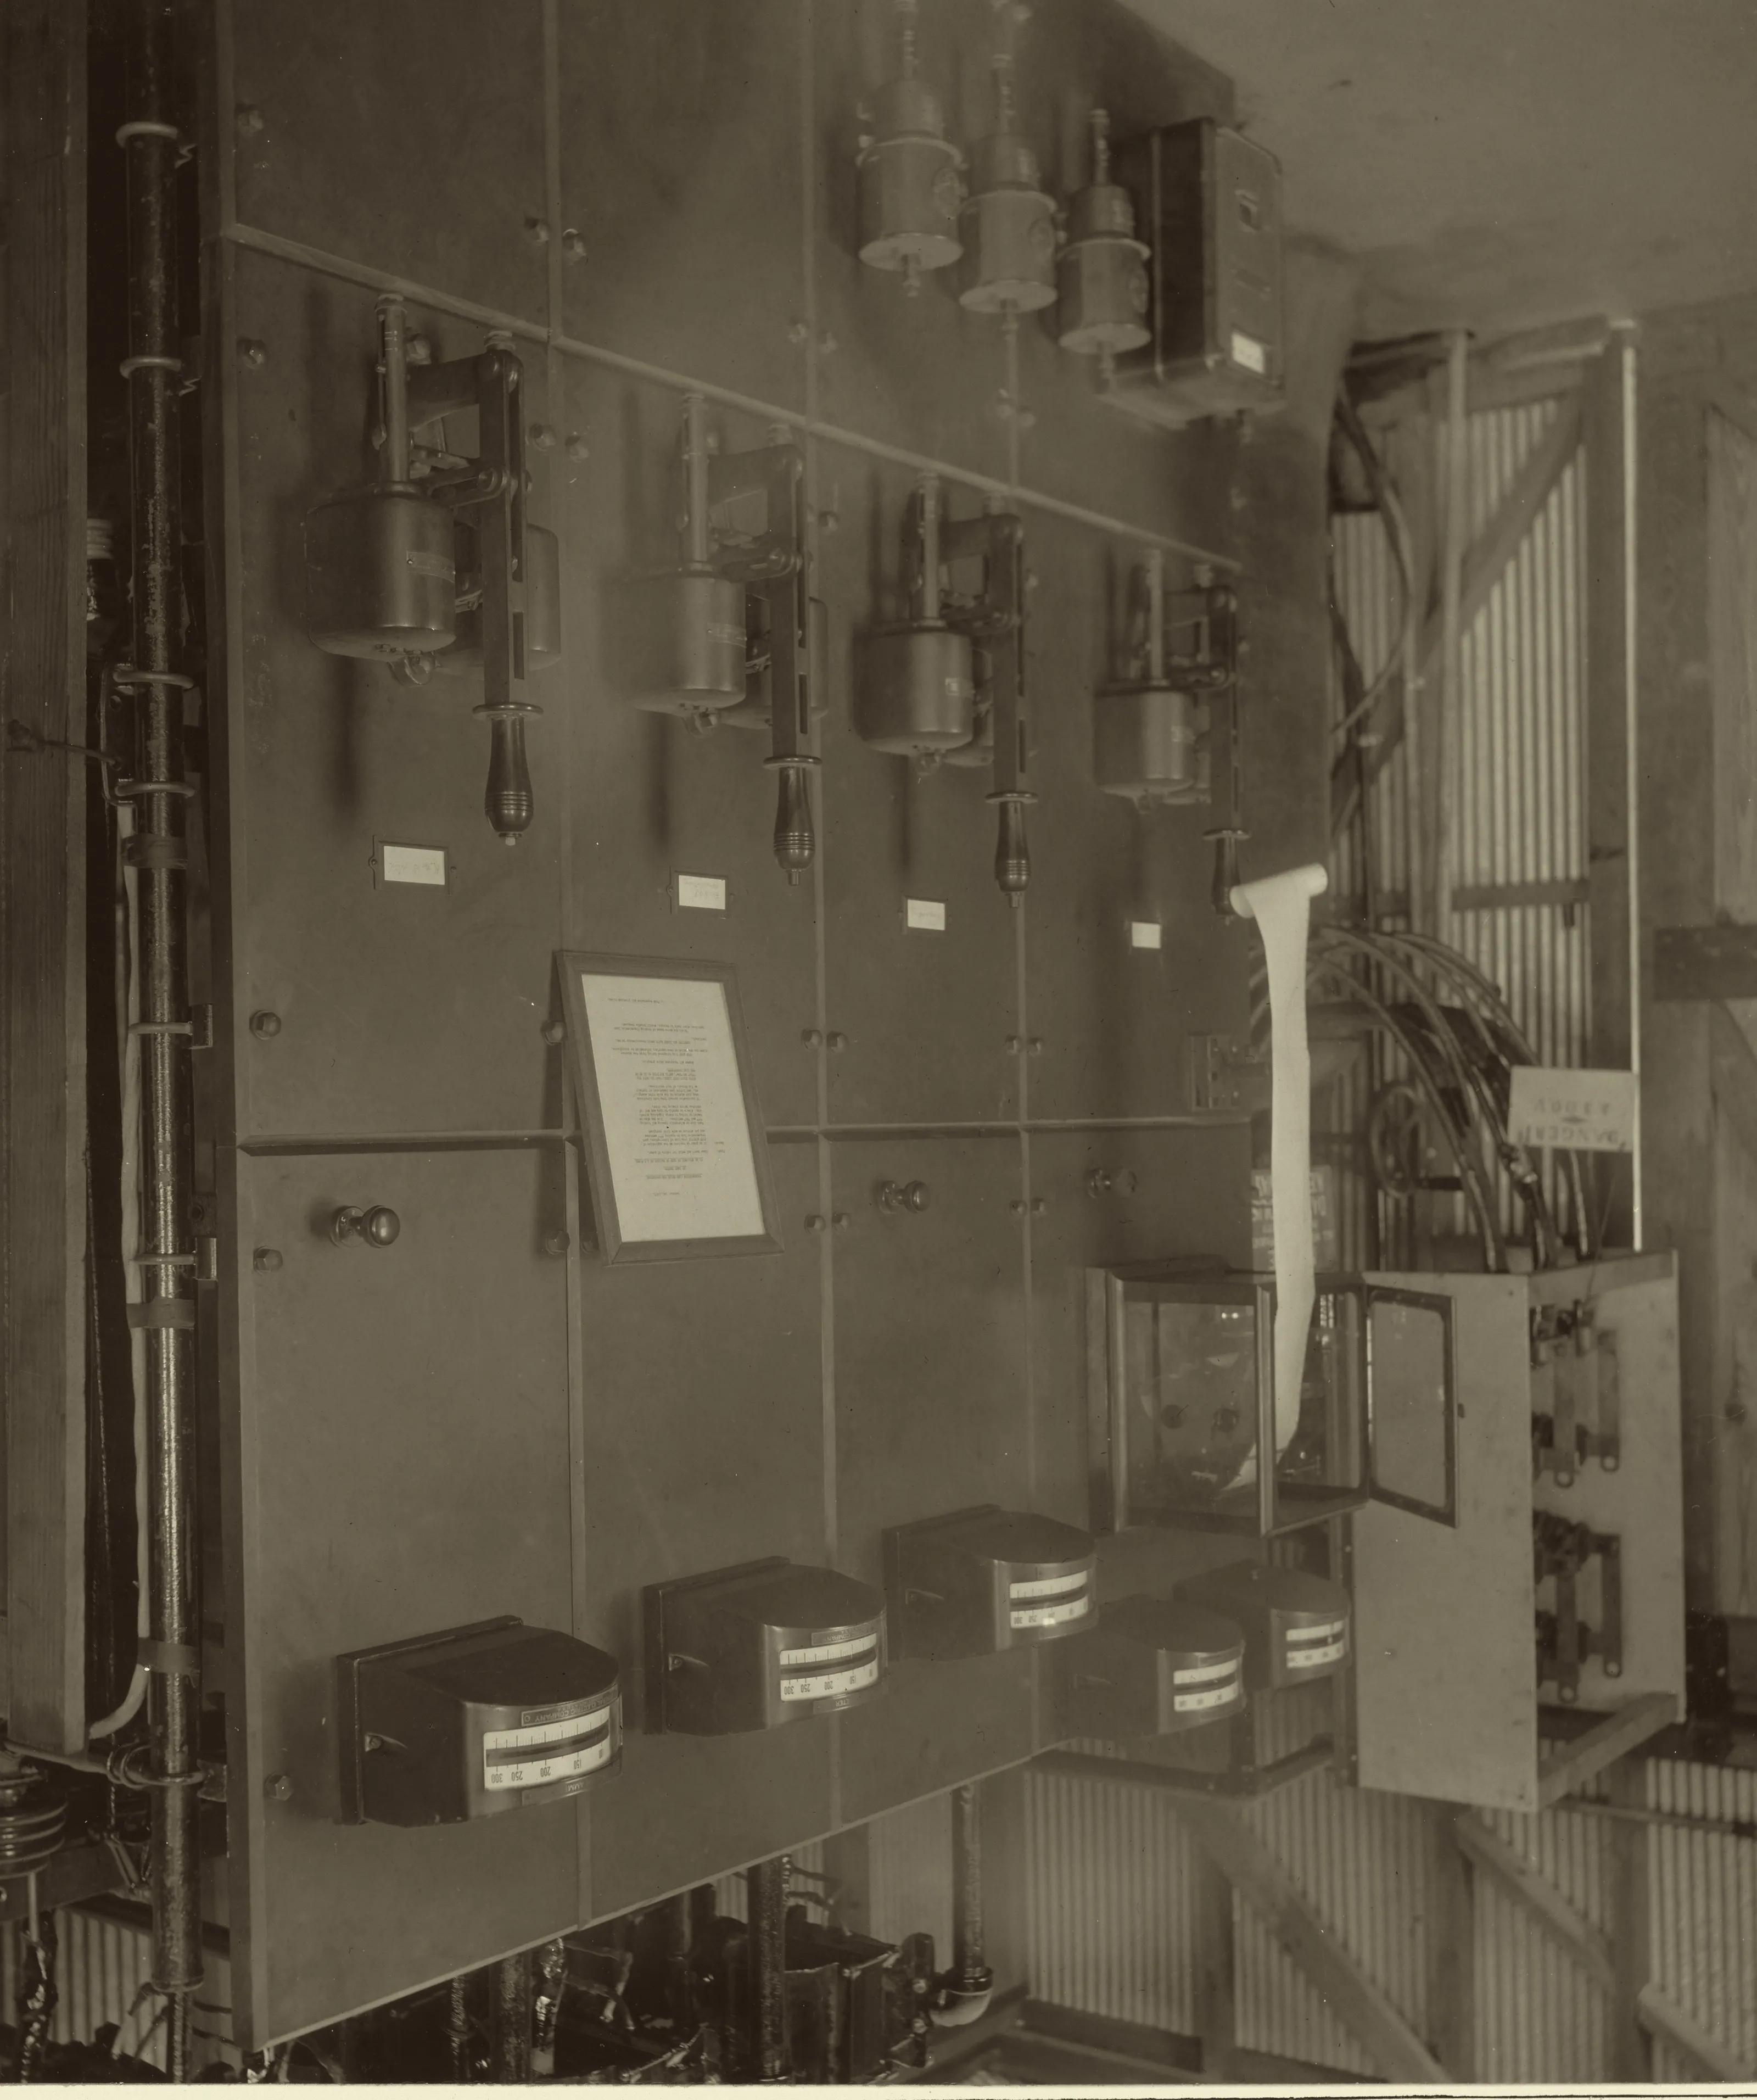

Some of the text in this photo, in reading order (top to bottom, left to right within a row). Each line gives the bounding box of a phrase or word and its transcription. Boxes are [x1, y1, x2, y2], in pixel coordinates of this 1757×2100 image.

[1536, 1125, 1618, 1145] DANGER
[801, 1684, 810, 1693] 250
[824, 1680, 833, 1690] 200
[784, 1686, 794, 1695] 300
[571, 1702, 595, 1715] ELECTRIC
[535, 1710, 569, 1722] COMPANY
[573, 1760, 581, 1770] 150
[511, 1771, 523, 1781] 250
[540, 1766, 551, 1777] 200
[491, 1773, 503, 1784] 300
